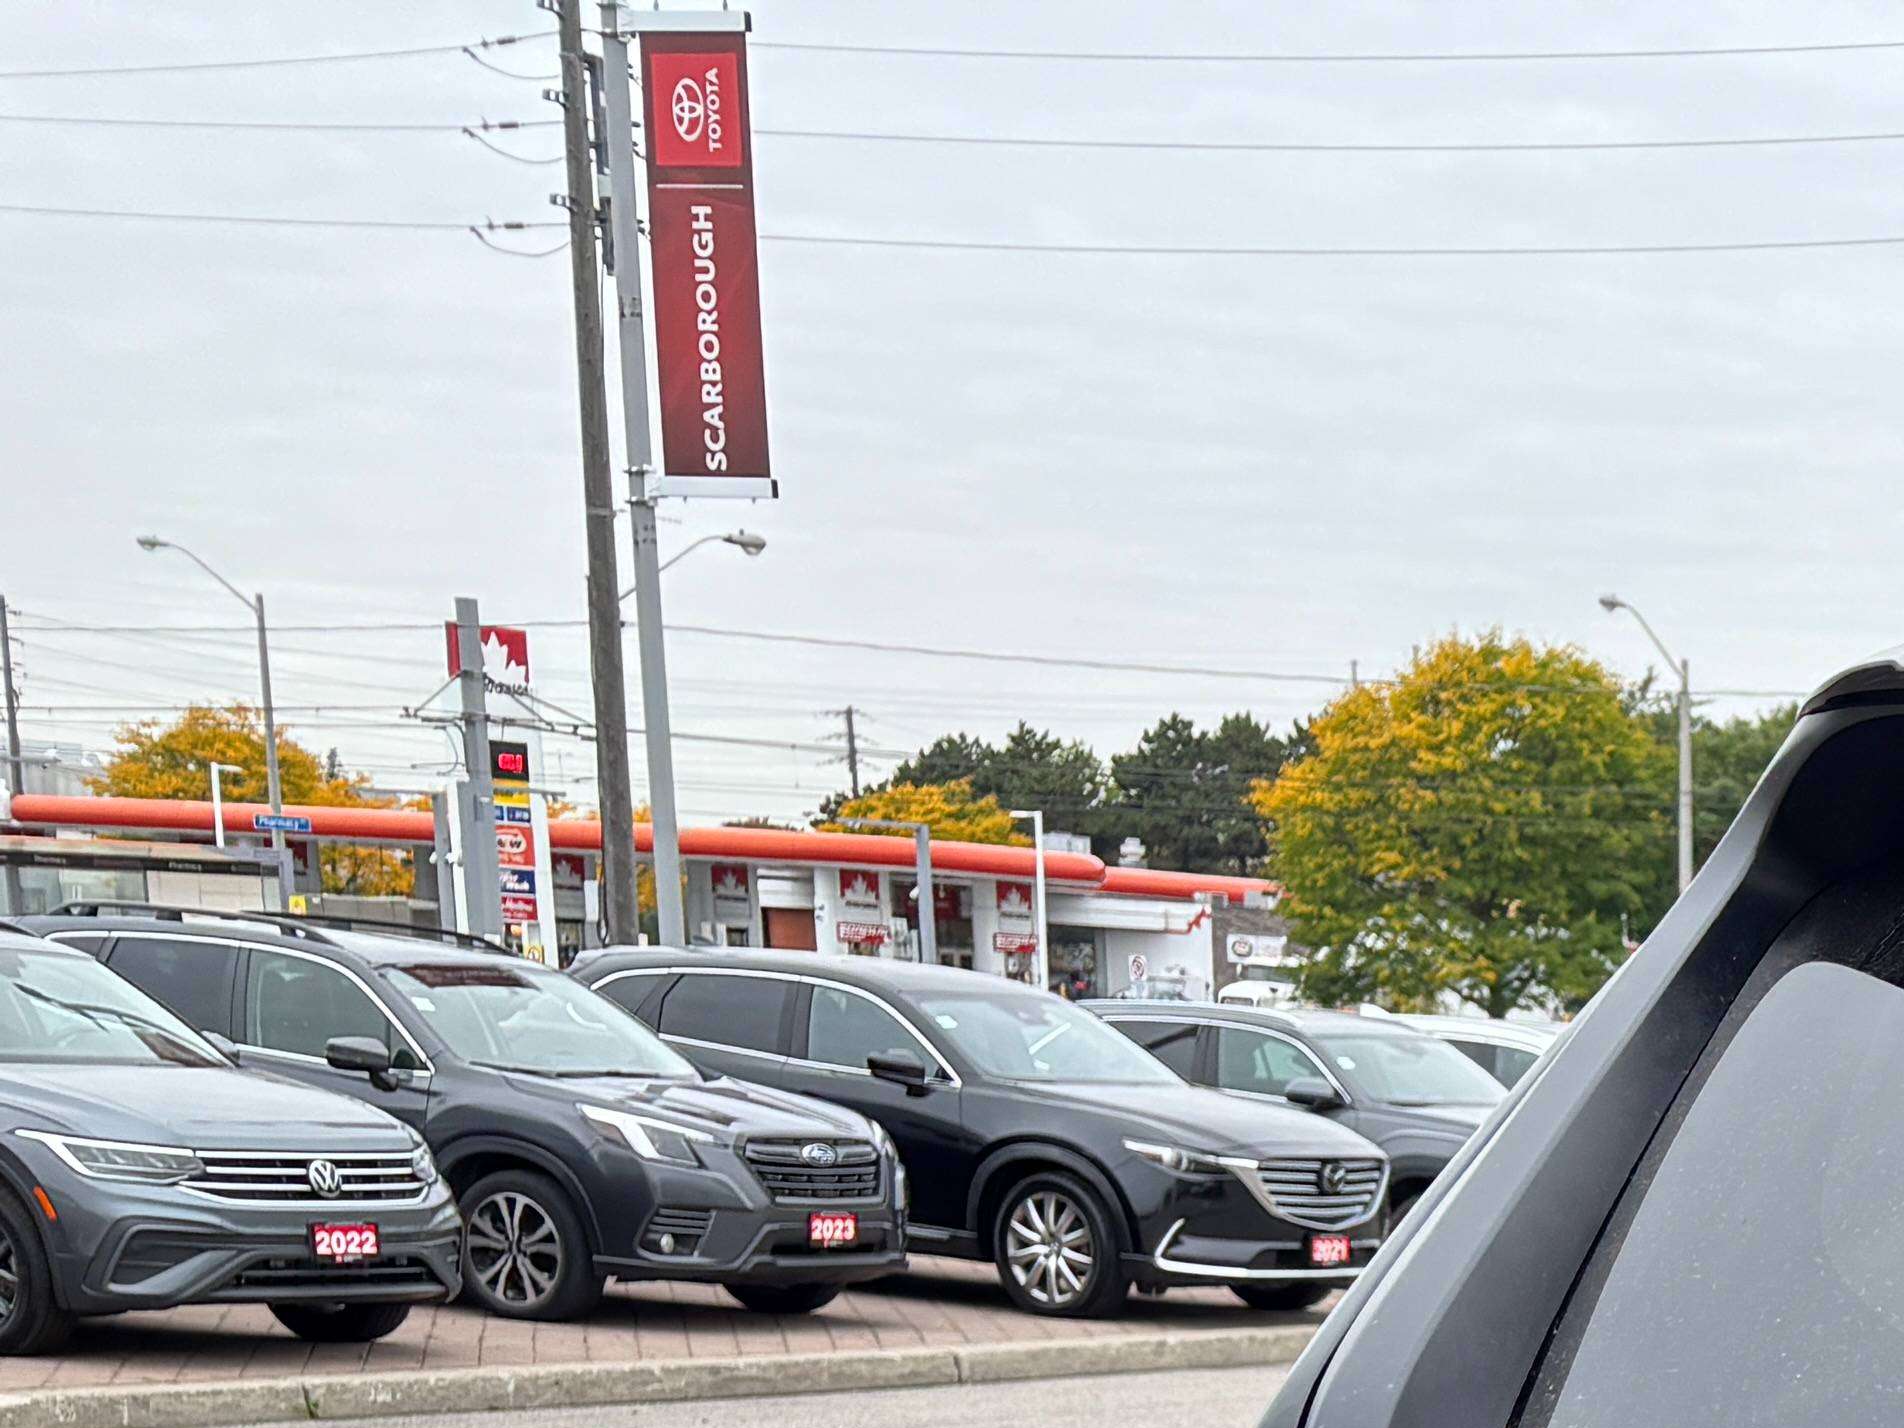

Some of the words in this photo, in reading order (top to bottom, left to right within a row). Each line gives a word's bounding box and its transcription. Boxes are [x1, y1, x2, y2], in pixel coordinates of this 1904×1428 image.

[706, 68, 722, 152] TOYOTA
[691, 205, 727, 471] SCARBOROUGH
[315, 1230, 377, 1255] 2022
[811, 1218, 855, 1240] 2023
